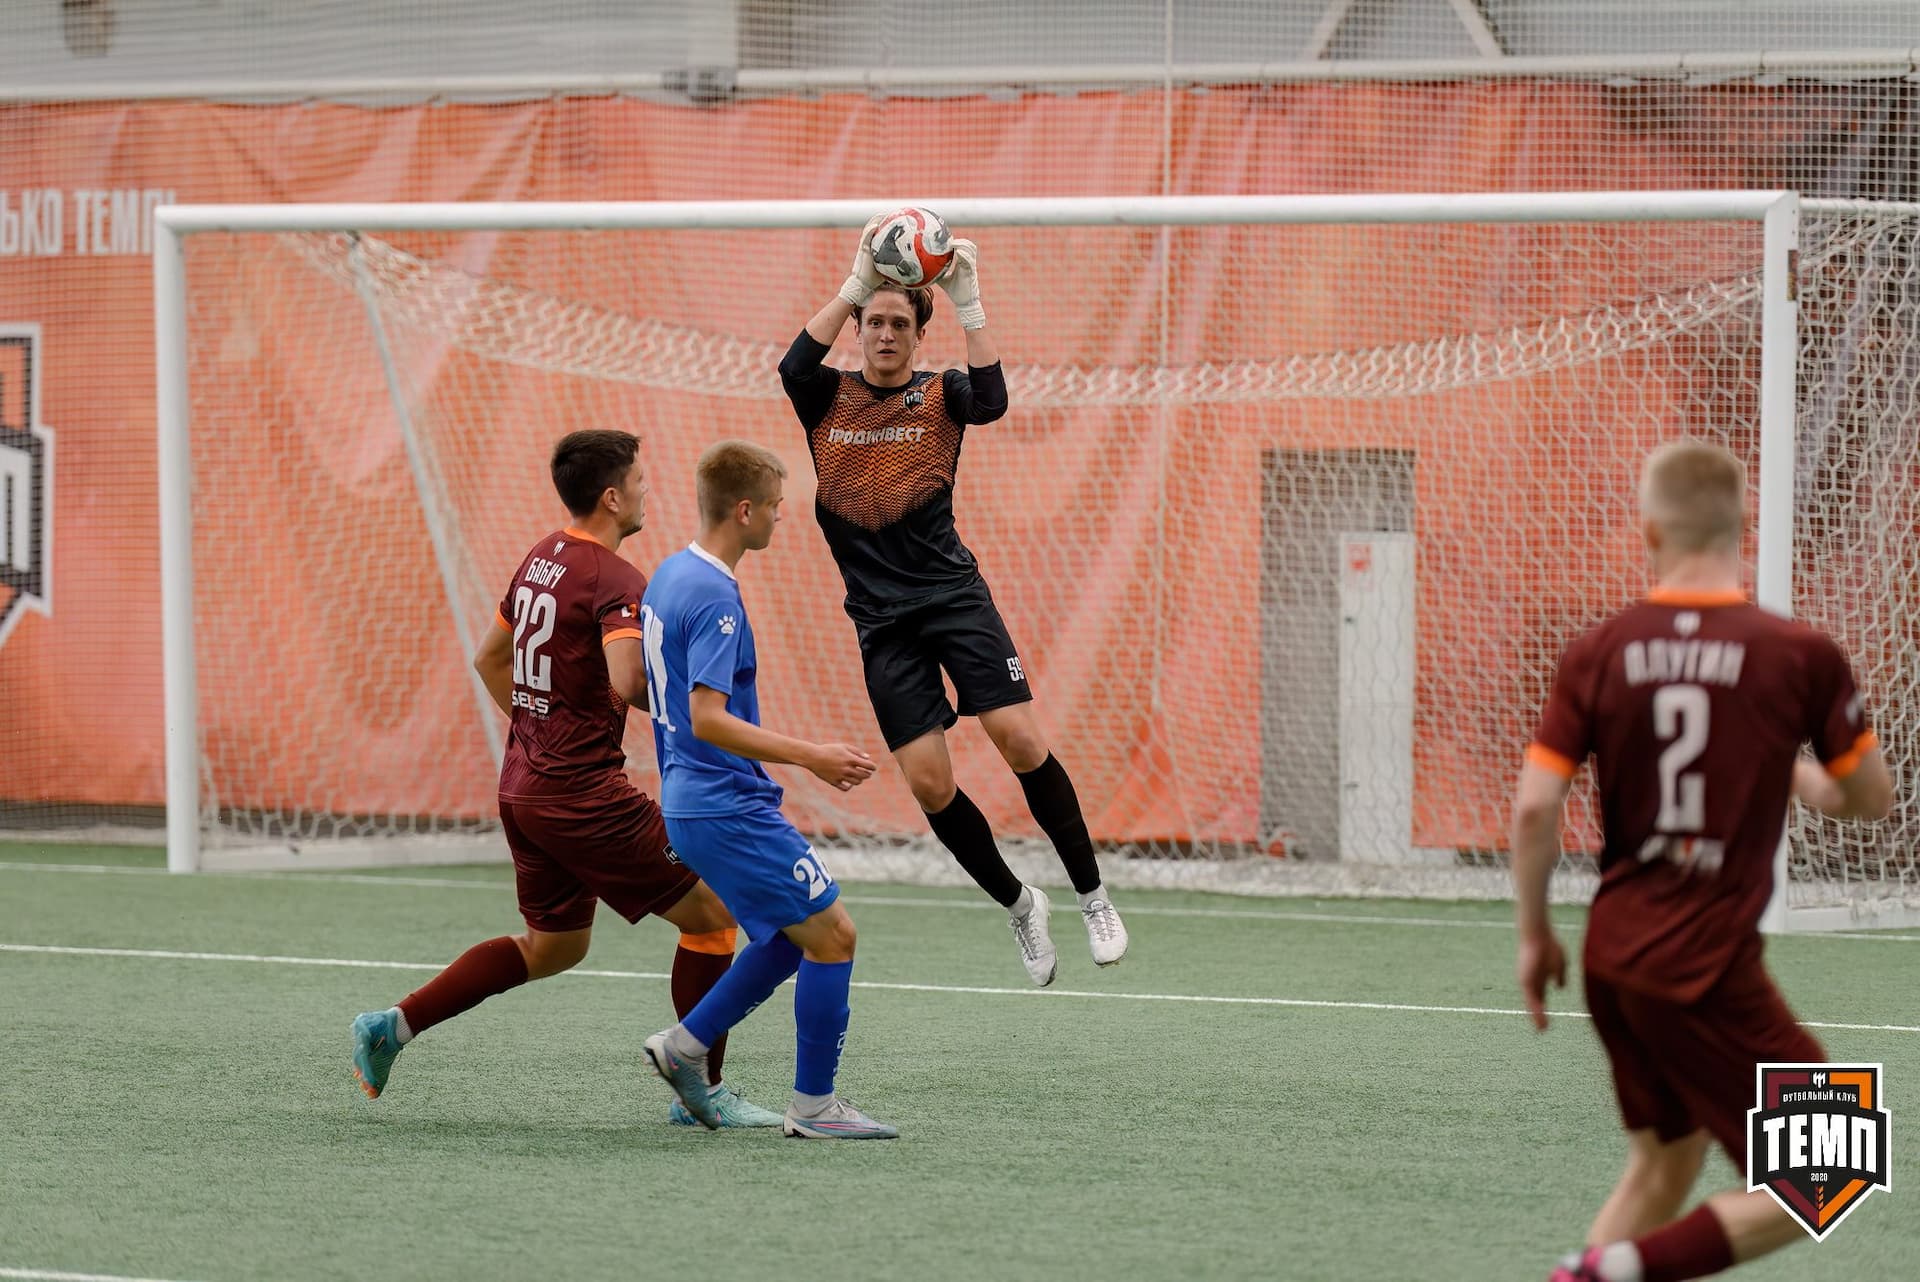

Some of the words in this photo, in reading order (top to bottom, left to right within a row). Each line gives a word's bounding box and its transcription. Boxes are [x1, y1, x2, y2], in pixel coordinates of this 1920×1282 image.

[75, 187, 176, 256] ТЕМП
[524, 557, 567, 589] БАБИЧ
[512, 586, 557, 692] 22
[1653, 683, 1710, 832] 2
